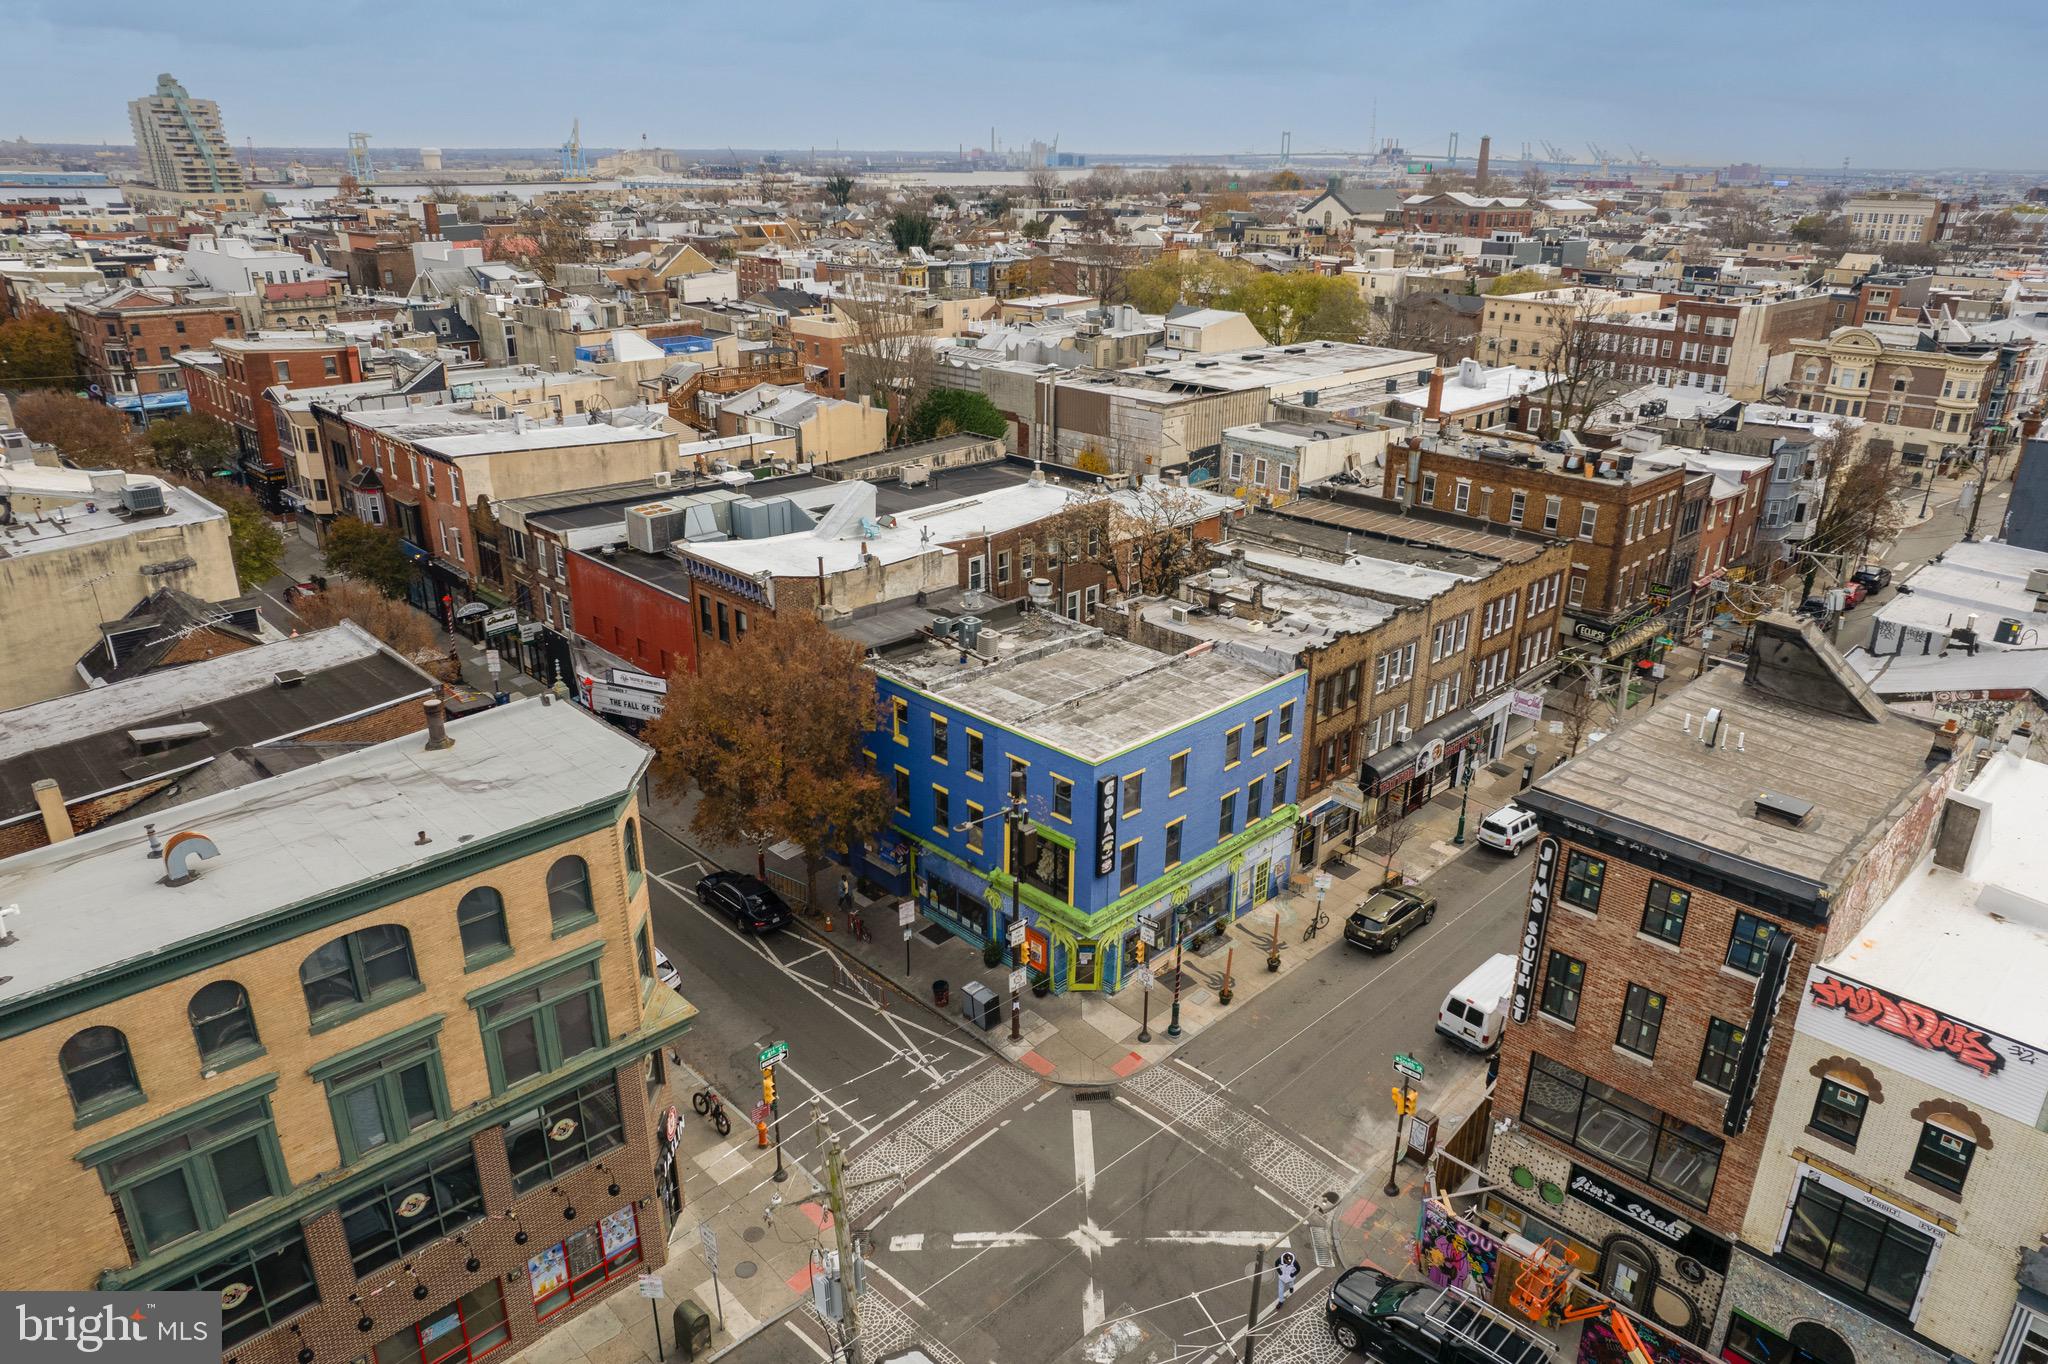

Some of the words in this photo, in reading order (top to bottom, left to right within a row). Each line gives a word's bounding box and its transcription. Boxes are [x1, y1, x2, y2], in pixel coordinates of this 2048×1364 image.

[1580, 626, 1606, 641] ECLIPSE
[610, 698, 622, 707] THE
[624, 701, 639, 711] FALL
[1531, 846, 1553, 914] JIMS
[1517, 920, 1539, 989] SOUTH
[1513, 993, 1526, 1021] ST
[1571, 1175, 1616, 1203] Jim's
[1627, 1203, 1685, 1239] Steaks
